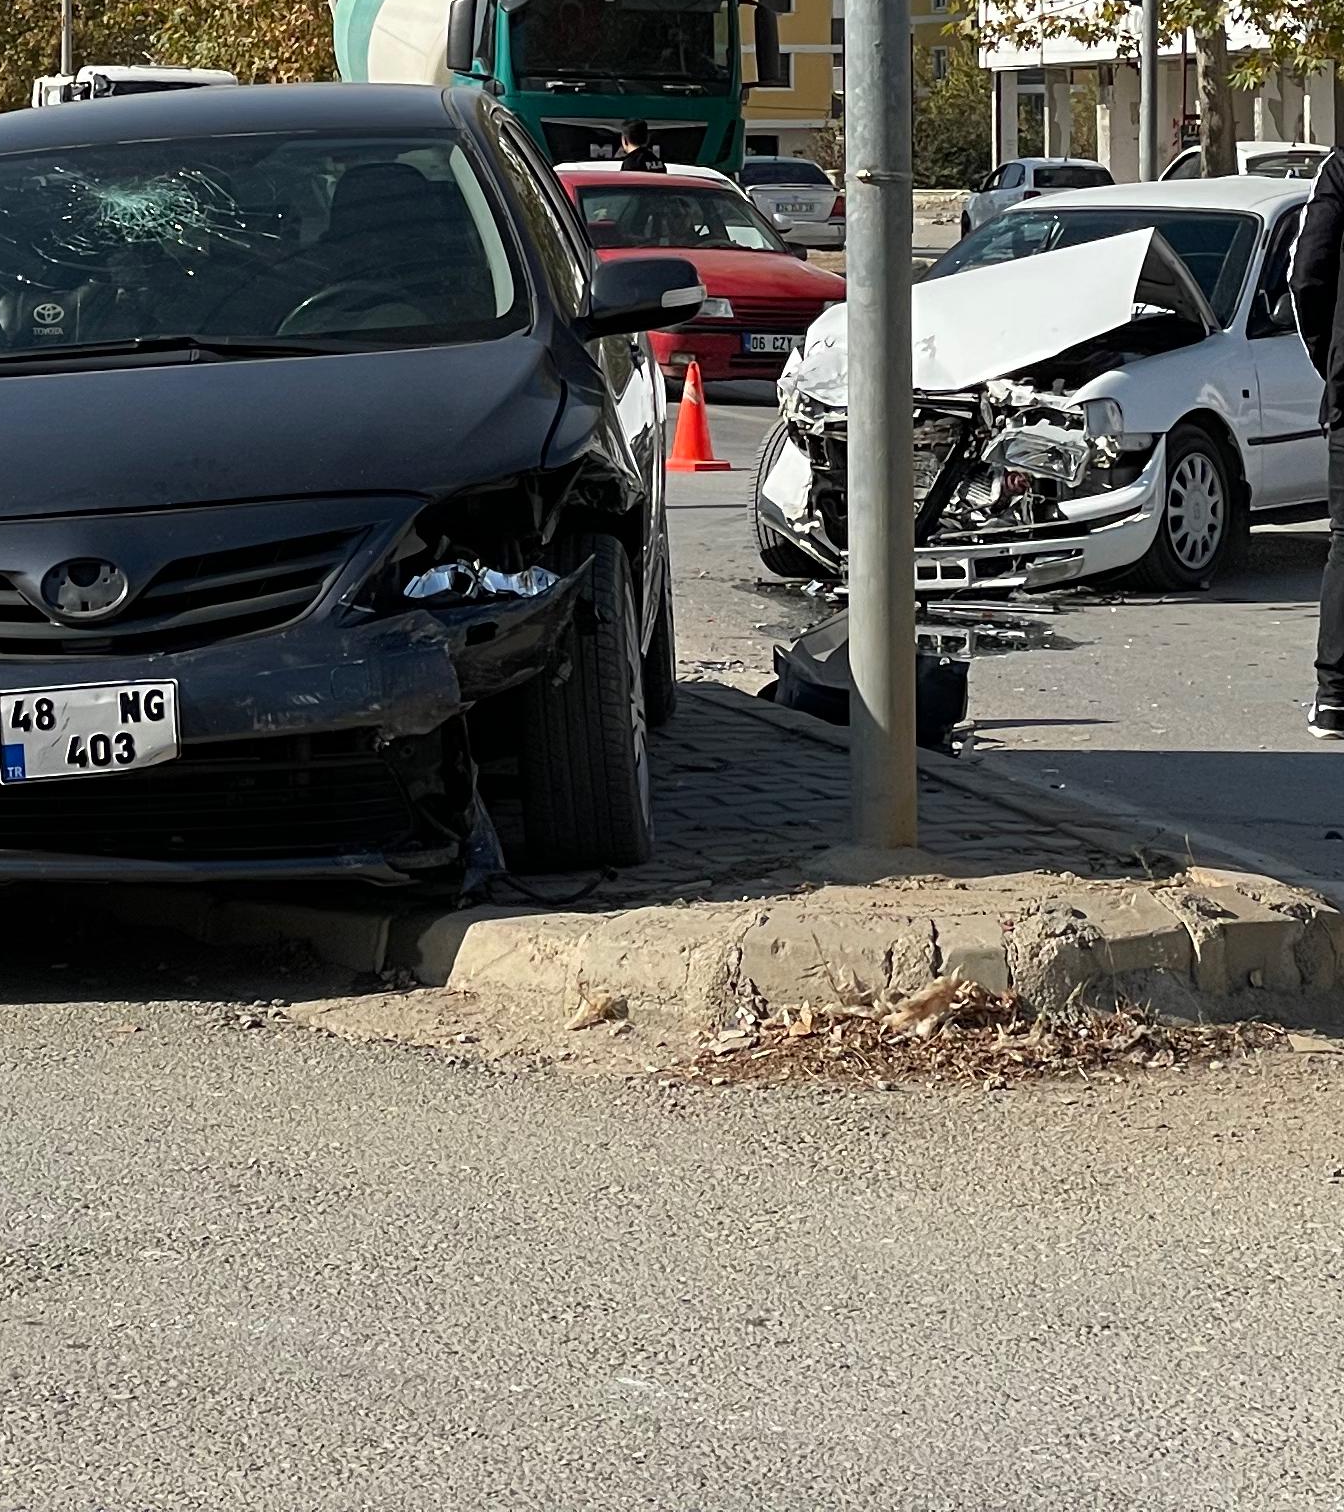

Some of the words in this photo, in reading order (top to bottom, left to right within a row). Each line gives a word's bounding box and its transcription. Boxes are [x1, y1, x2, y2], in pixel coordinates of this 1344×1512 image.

[32, 326, 64, 336] TOYOTA
[752, 336, 766, 350] 06
[772, 336, 793, 353] CZY
[11, 697, 56, 732] 48
[119, 689, 165, 724] NG
[67, 732, 135, 768] 403
[7, 766, 23, 778] TR
